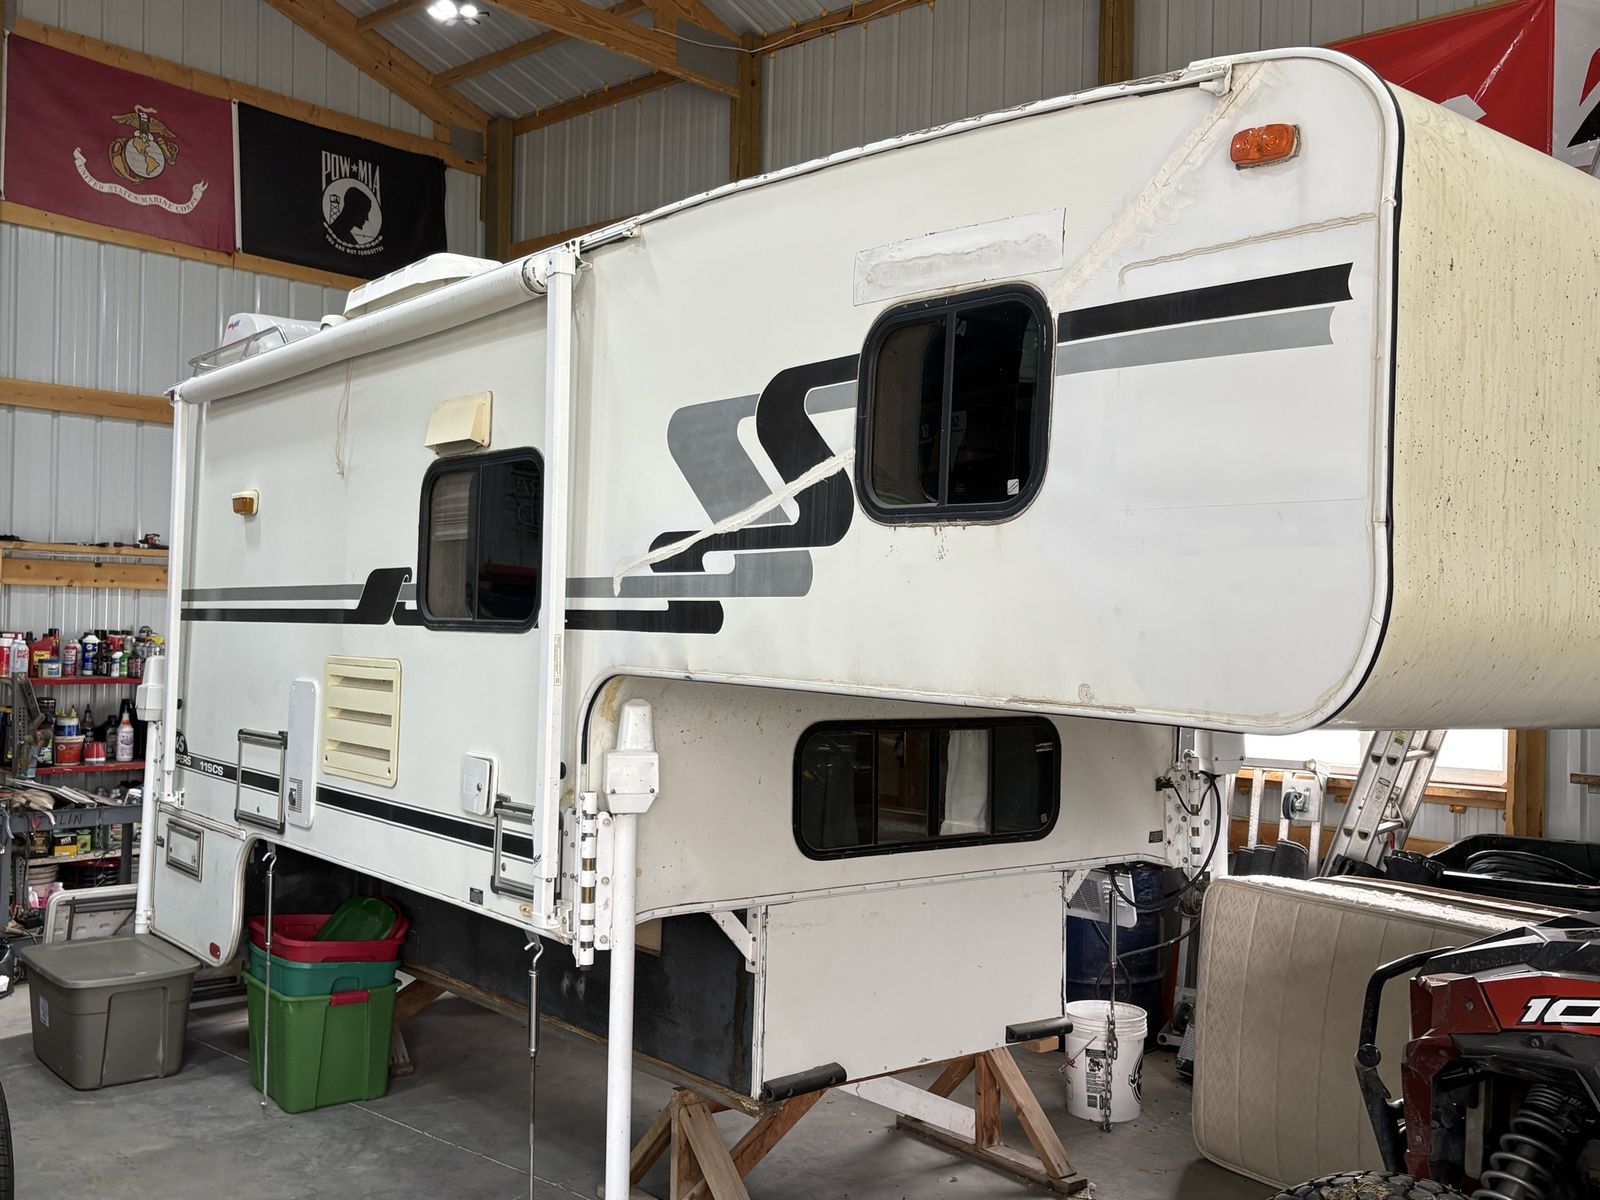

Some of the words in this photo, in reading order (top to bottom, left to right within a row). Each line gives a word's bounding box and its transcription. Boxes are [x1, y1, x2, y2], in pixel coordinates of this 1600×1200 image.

[77, 164, 104, 190] UNITED
[108, 184, 138, 201] STATES
[141, 196, 175, 210] MARINE
[175, 197, 198, 213] CORPS
[321, 150, 351, 191] POW
[358, 159, 381, 206] MIA
[325, 234, 335, 245] YOU
[335, 243, 345, 252] ARE
[200, 761, 224, 776] 11SCS
